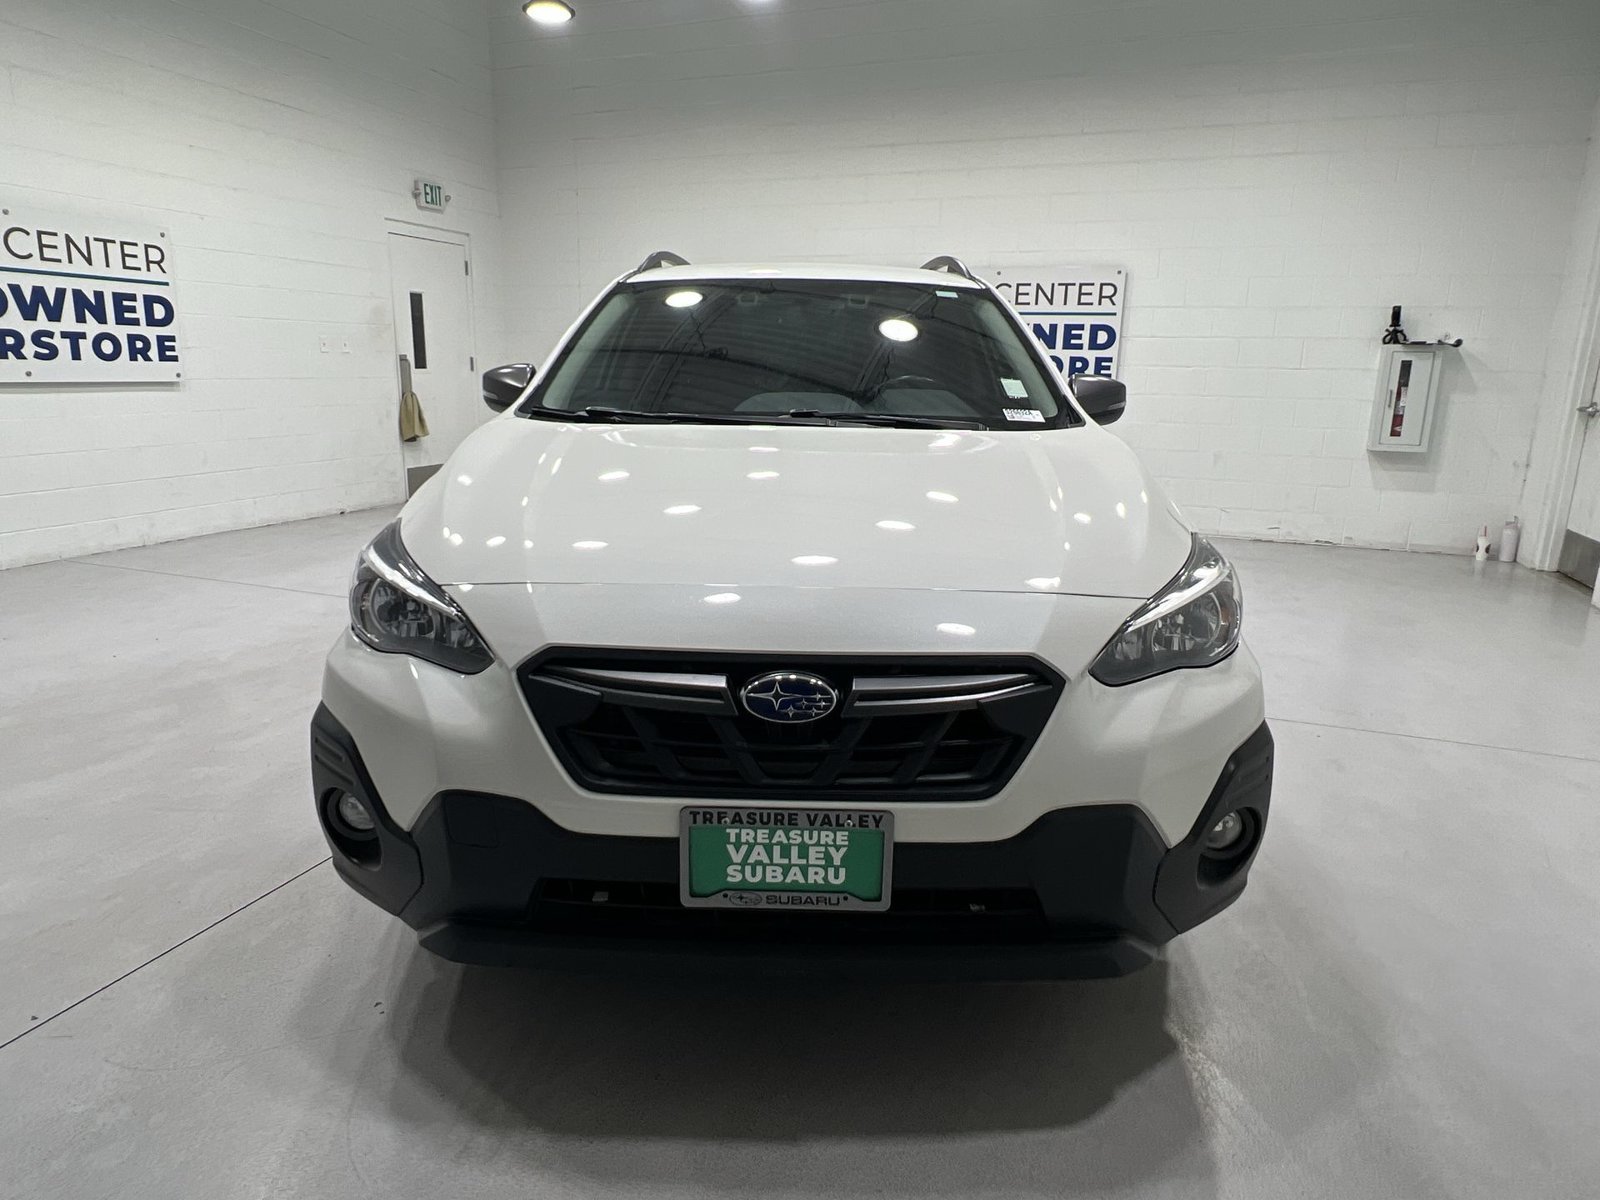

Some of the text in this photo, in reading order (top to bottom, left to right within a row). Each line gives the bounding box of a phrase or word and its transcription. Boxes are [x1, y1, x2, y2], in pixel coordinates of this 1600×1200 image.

[424, 183, 442, 206] EXIT
[3, 226, 167, 274] CENTER
[0, 283, 174, 327] WNED
[0, 328, 179, 362] RSTORE
[1029, 323, 1117, 350] NED
[689, 811, 884, 828] TREASURE VALLEY
[726, 828, 849, 845] TREASURE
[726, 844, 848, 865] VALLEY
[726, 865, 846, 884] SUBARU
[765, 895, 840, 906] SUBARU
